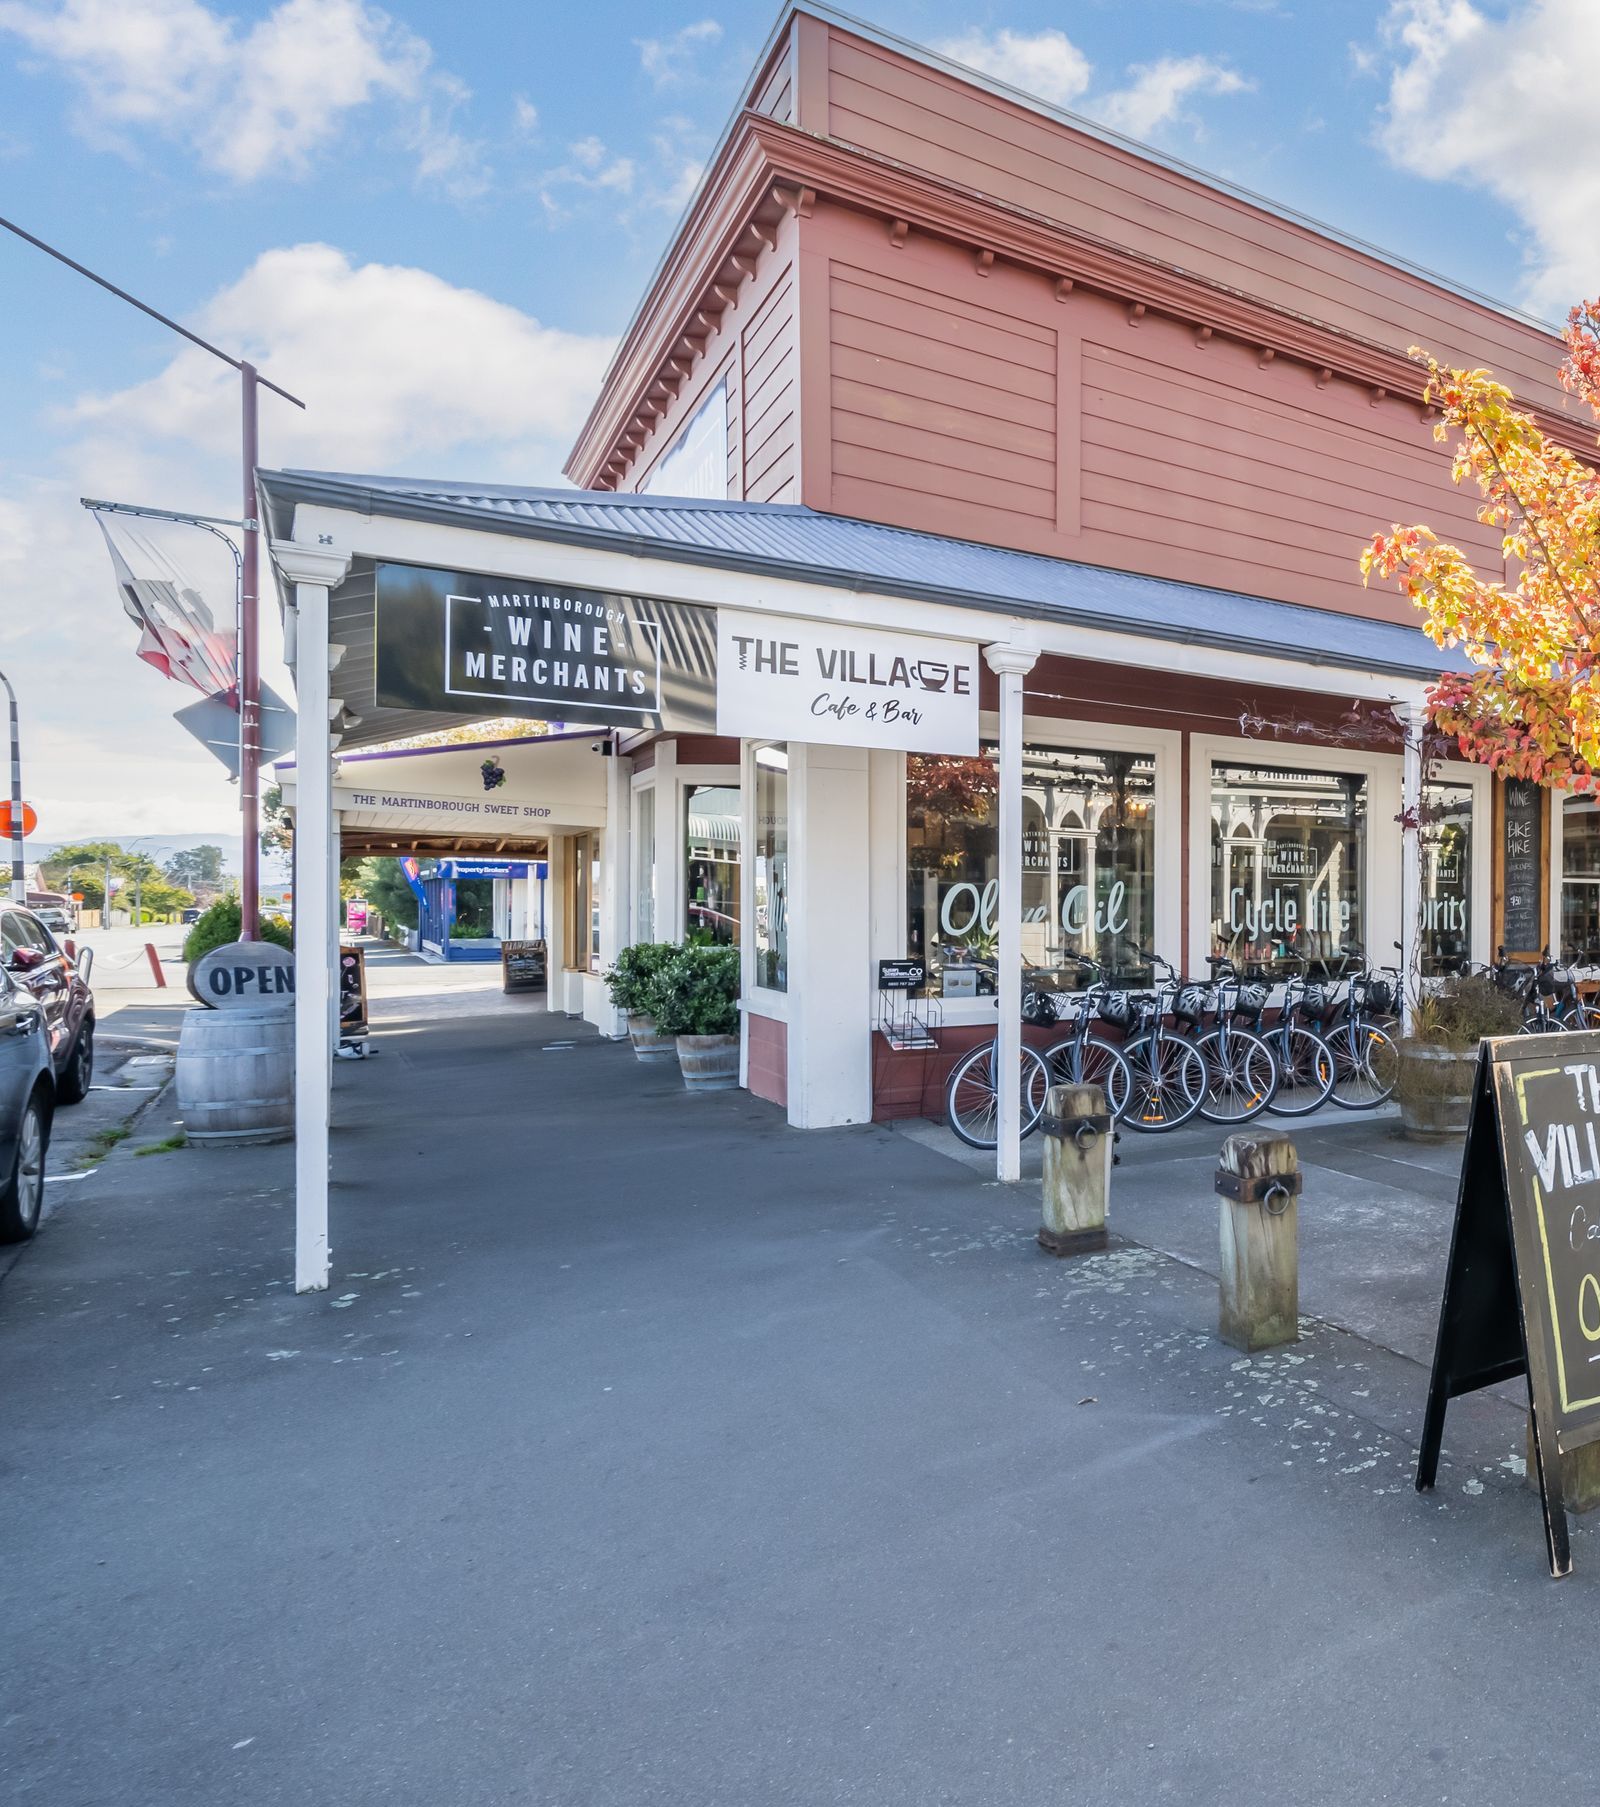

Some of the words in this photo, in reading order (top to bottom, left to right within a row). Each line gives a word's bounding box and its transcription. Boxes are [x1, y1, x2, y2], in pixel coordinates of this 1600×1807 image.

[487, 594, 626, 625] MARTINBOROUGH
[507, 615, 608, 656] WINE
[465, 651, 646, 695] MERCHANTS
[731, 635, 799, 676] THE
[815, 647, 970, 696] VILLAGE
[810, 692, 861, 721] Cafe
[865, 701, 878, 721] &
[881, 699, 923, 726] Bar
[353, 794, 376, 805] THE
[381, 797, 480, 813] MARTINBOROUGH
[484, 804, 519, 816] SWEET
[523, 807, 551, 818] SHOP
[1507, 821, 1532, 838] BIKE
[1023, 840, 1048, 853] WIN
[1281, 850, 1305, 862] WINE
[1507, 839, 1531, 858] HIRE
[1062, 880, 1129, 935] Oil
[1231, 887, 1297, 942] Cycle
[209, 965, 295, 996] OPEN
